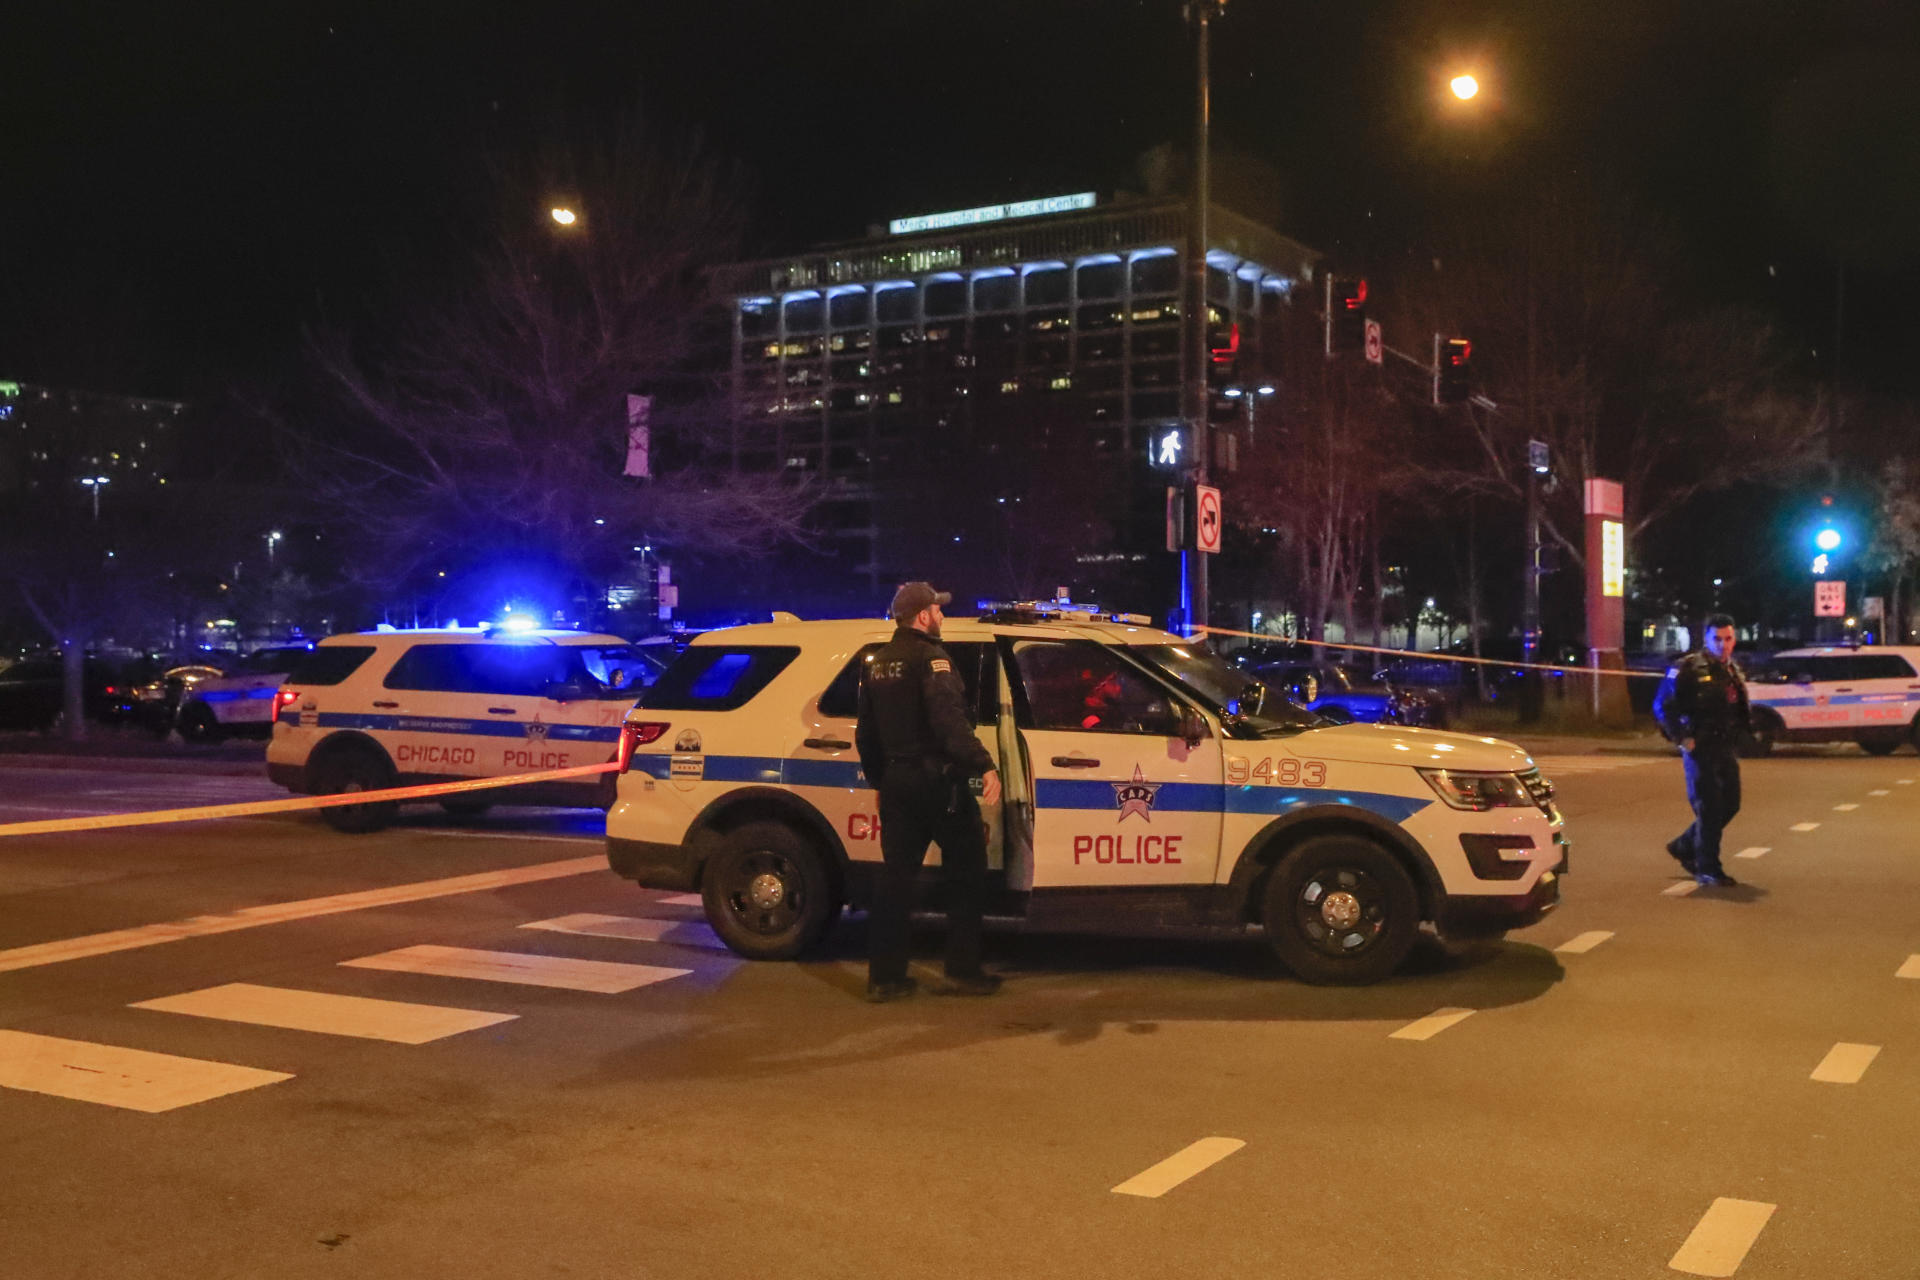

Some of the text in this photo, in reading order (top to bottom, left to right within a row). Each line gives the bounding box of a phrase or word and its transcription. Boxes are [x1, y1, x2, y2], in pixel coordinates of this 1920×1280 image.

[900, 197, 1086, 232] Mercy Hospital and Medical Center
[1821, 594, 1841, 602] WAY
[1864, 709, 1904, 719] POLICE
[397, 745, 570, 768] CHICAGO POLICE
[1228, 757, 1327, 787] 9483
[1119, 789, 1153, 802] CAPS
[1074, 835, 1183, 864] POLICE
